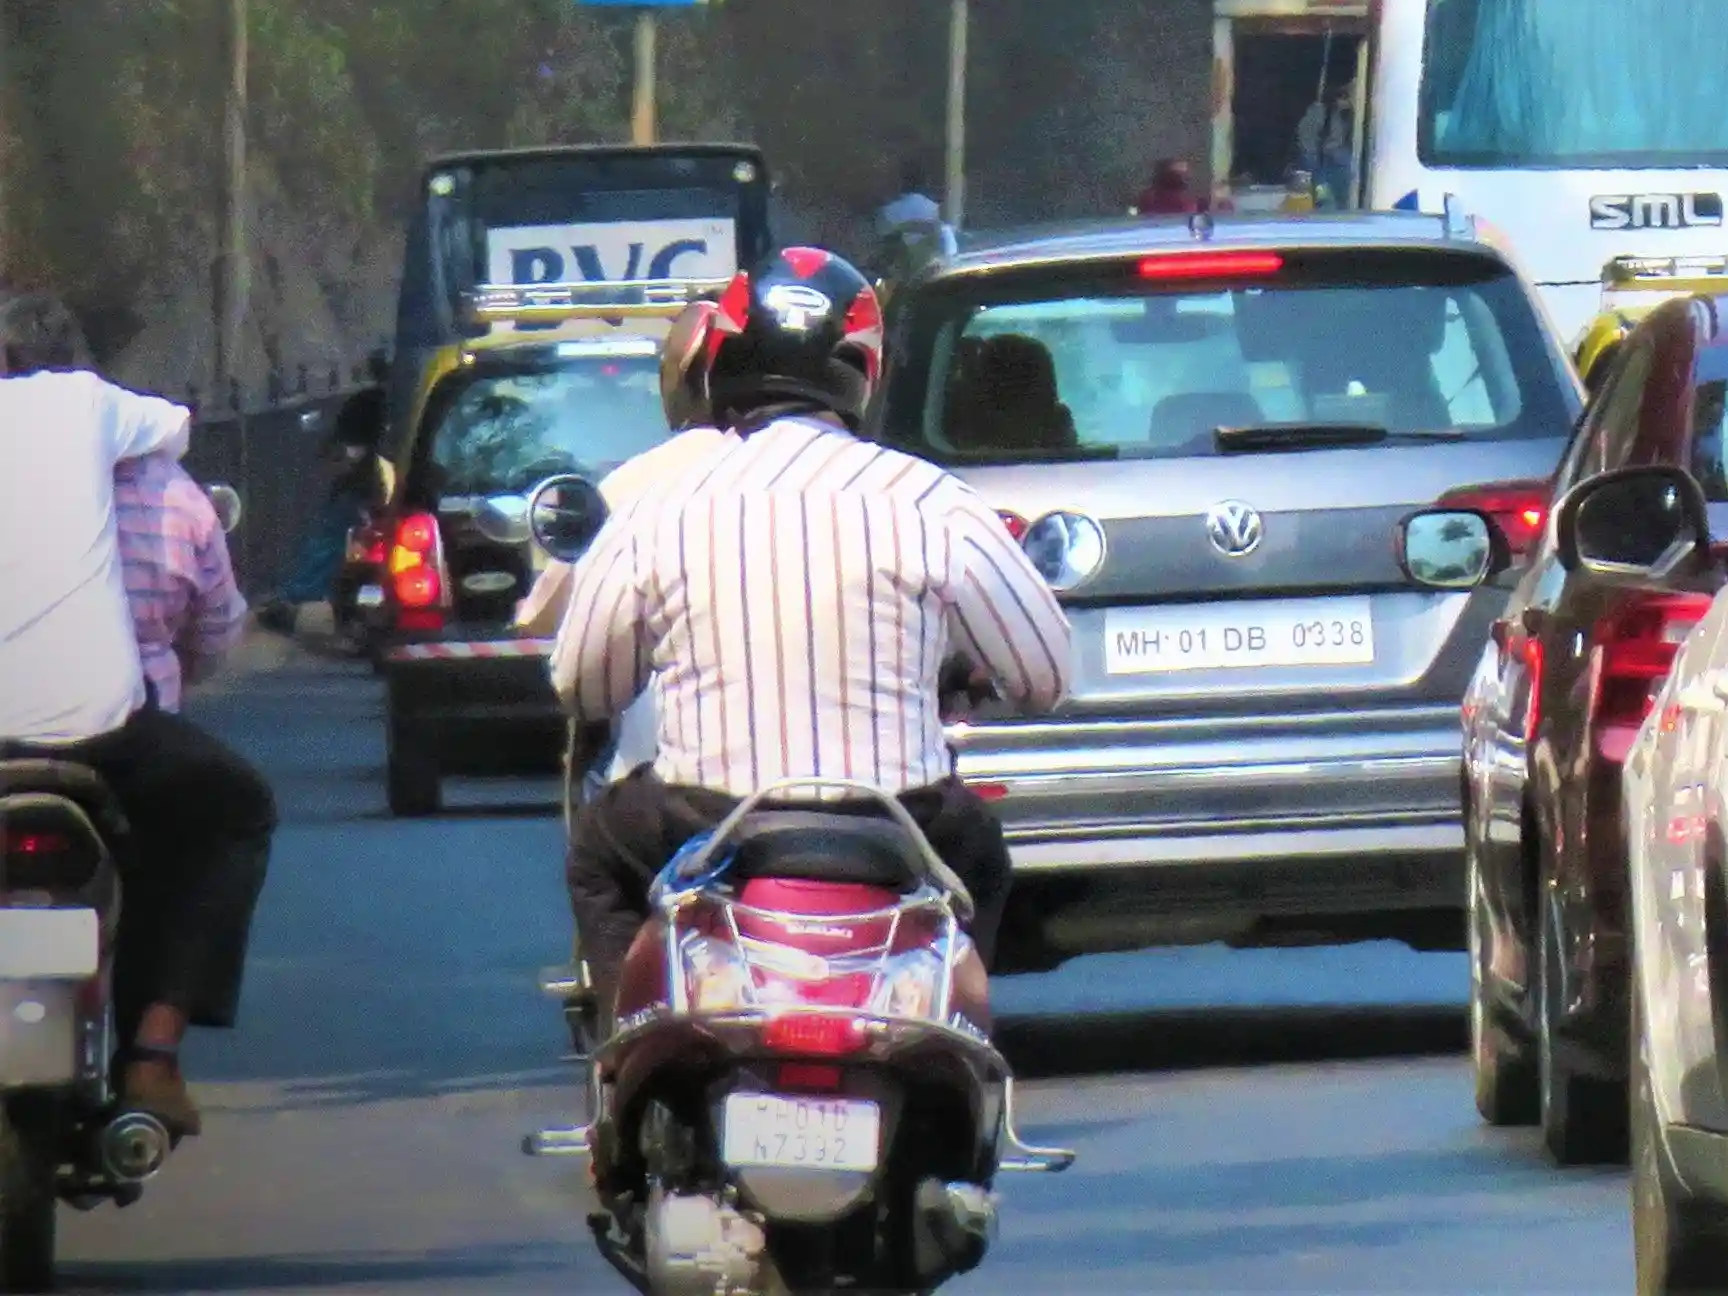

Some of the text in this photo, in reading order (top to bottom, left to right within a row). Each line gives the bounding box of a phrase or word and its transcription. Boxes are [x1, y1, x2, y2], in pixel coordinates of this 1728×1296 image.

[1116, 630, 1161, 655] MH
[1224, 626, 1267, 651] DB
[1292, 621, 1364, 647] 0338
